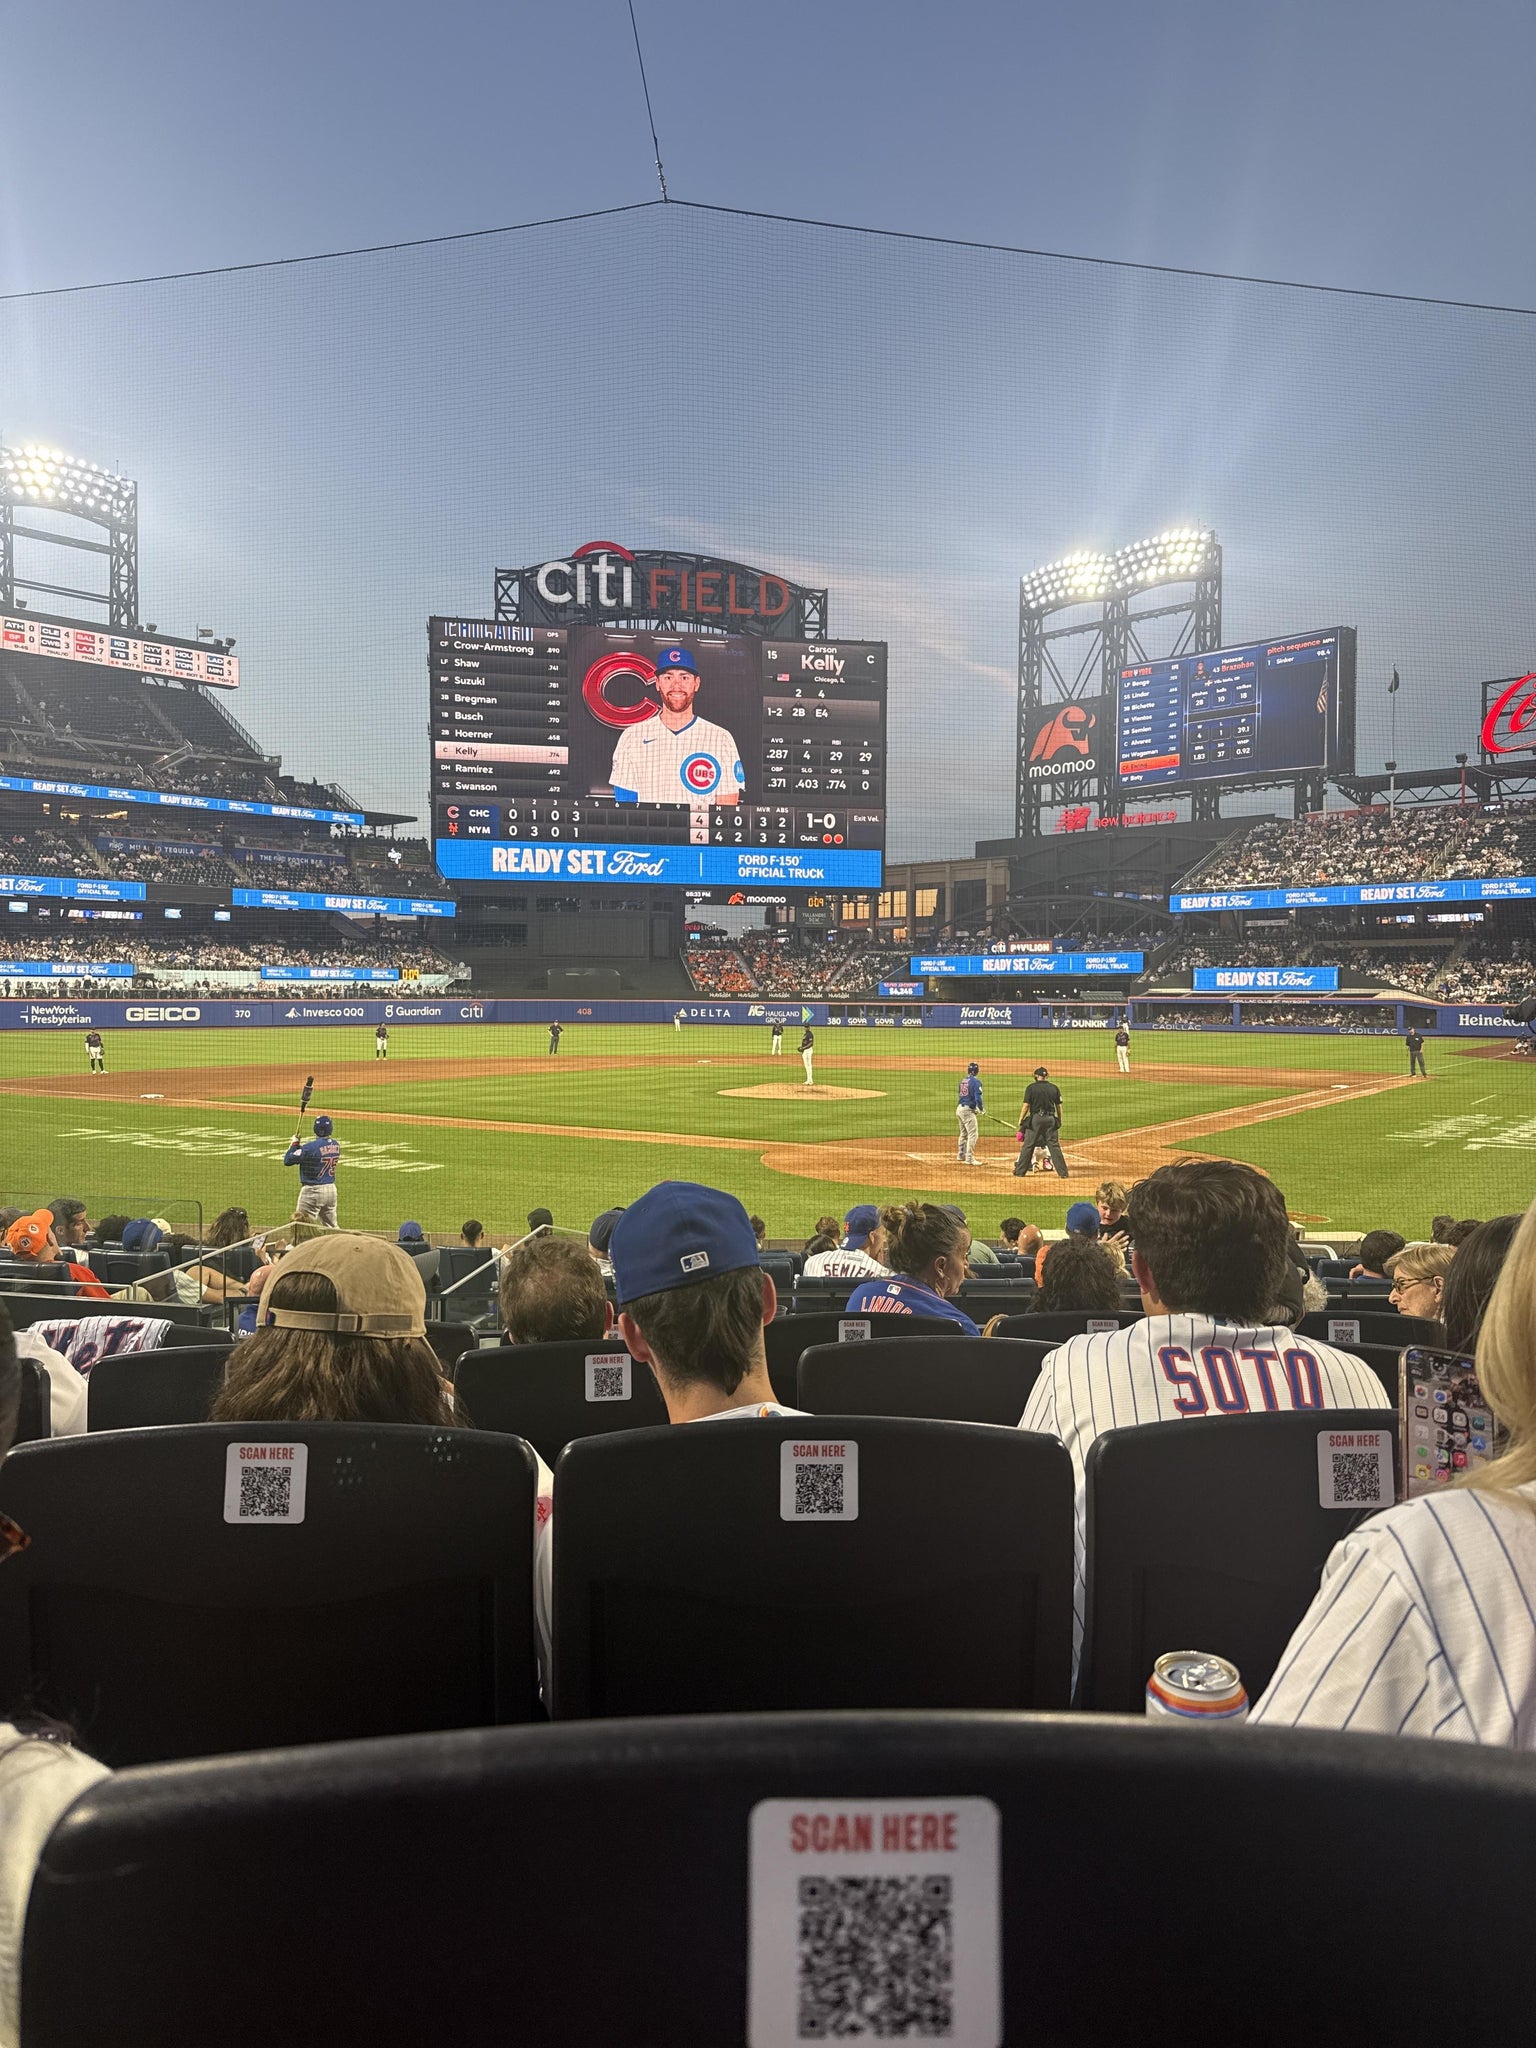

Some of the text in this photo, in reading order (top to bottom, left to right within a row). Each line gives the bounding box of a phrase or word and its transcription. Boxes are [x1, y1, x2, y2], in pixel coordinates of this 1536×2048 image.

[650, 569, 789, 616] FIELD
[5, 622, 24, 630] ATH
[144, 645, 161, 653] NYY
[454, 641, 534, 655] Crow-Armstrong
[808, 646, 837, 654] Carson
[1267, 645, 1285, 656] pitch
[1286, 639, 1320, 651] sequence
[144, 656, 161, 664] DET
[176, 651, 193, 659] HOU
[207, 656, 223, 664] LAD
[768, 651, 777, 659] 15
[454, 659, 480, 668] Shaw
[802, 655, 845, 675] Kelly
[208, 667, 223, 675] MIN
[454, 676, 485, 685] Suzuki
[814, 676, 838, 684] Chicago,
[796, 689, 825, 698] 2 4
[454, 694, 497, 705] Bregman
[455, 712, 483, 721] Busch
[768, 708, 828, 717] 1-2 2B E4
[455, 730, 493, 739] Hoerner
[456, 747, 478, 757] Kelly
[767, 750, 872, 761] .287 4 29 29
[1029, 759, 1095, 778] moomoo
[456, 782, 497, 791] Swanson
[768, 779, 869, 790] .371 .403 .774 0
[469, 809, 786, 827] CHC 0 1 0 3 4 6 0 3 2
[807, 813, 835, 829] 1-0
[1094, 810, 1177, 828] new balance
[469, 825, 786, 843] NYM 0 3 0 1 4 4 2 3 2
[493, 848, 663, 876] READY SET Ford
[739, 855, 768, 865] FORD
[739, 868, 824, 878] OFFICIAL TRUCK
[1361, 886, 1447, 901] READY SET Ford
[747, 895, 786, 903] moomoo
[808, 898, 823, 907] 0:09
[1181, 896, 1253, 909] READY SET Ford
[983, 958, 1054, 971] READY SET Ford
[403, 969, 419, 980] 0:09
[1216, 971, 1315, 987] READY SET Ford
[31, 1006, 78, 1014] NewYork-
[126, 1008, 200, 1021] GEICO
[235, 1010, 250, 1018] 370
[303, 1007, 364, 1017] Invesco QQQ
[397, 1006, 441, 1016] Guardian
[691, 1008, 731, 1017] DELTA
[961, 1007, 1012, 1019] Hard Rock
[31, 1015, 91, 1026] Presbyterian
[828, 1017, 841, 1025] 380
[1072, 1020, 1108, 1028] DUNKIN'
[1339, 1027, 1398, 1035] CADILLAC
[609, 1356, 624, 1364] HERE
[1158, 1346, 1324, 1414] SOTO
[1329, 1434, 1380, 1447] SCAN HERE
[240, 1447, 294, 1460] SCAN HERE
[793, 1445, 845, 1457] SCAN HERE
[791, 1812, 957, 1853] SCAN HERE
